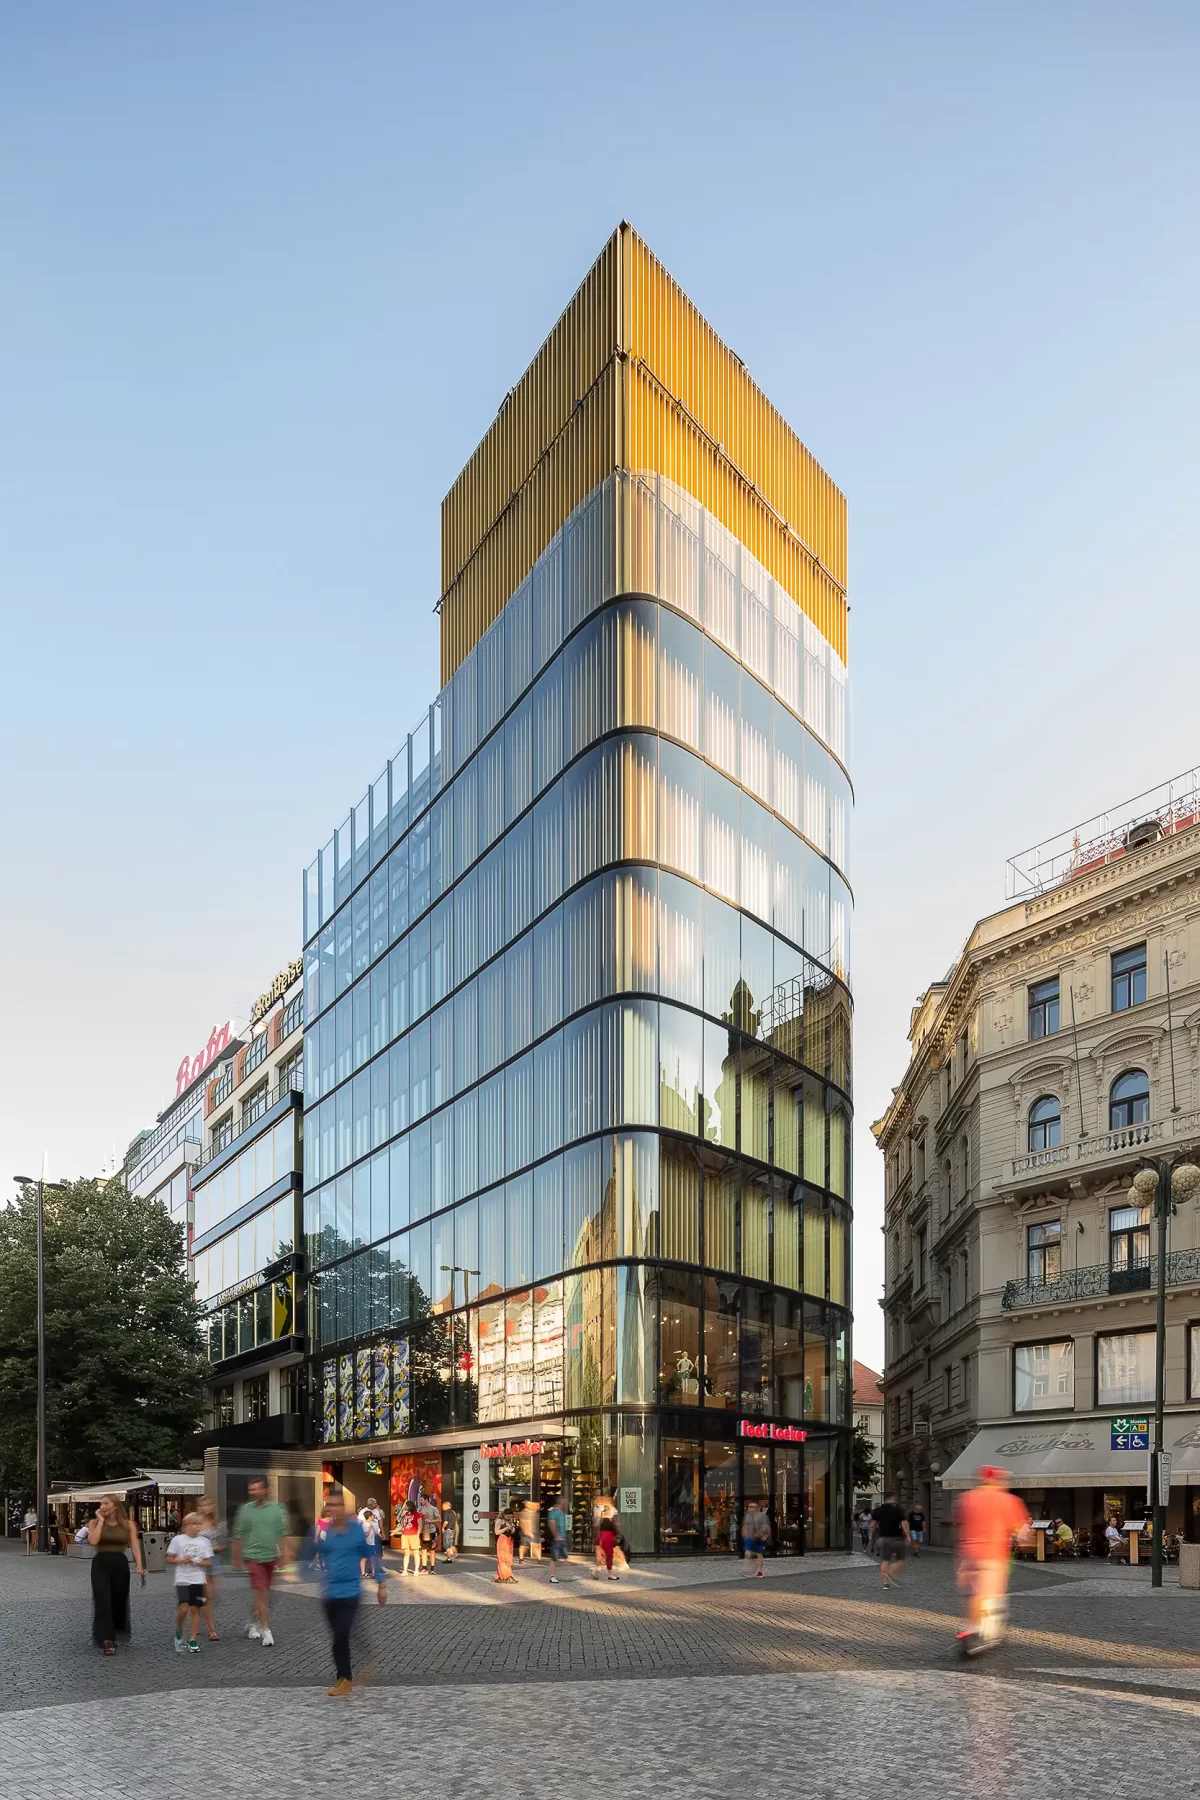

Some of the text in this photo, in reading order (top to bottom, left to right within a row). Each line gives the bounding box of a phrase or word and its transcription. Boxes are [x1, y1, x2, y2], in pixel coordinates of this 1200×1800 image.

[741, 1420, 807, 1442] Foot Locker
[480, 1439, 544, 1459] Foot Locker
